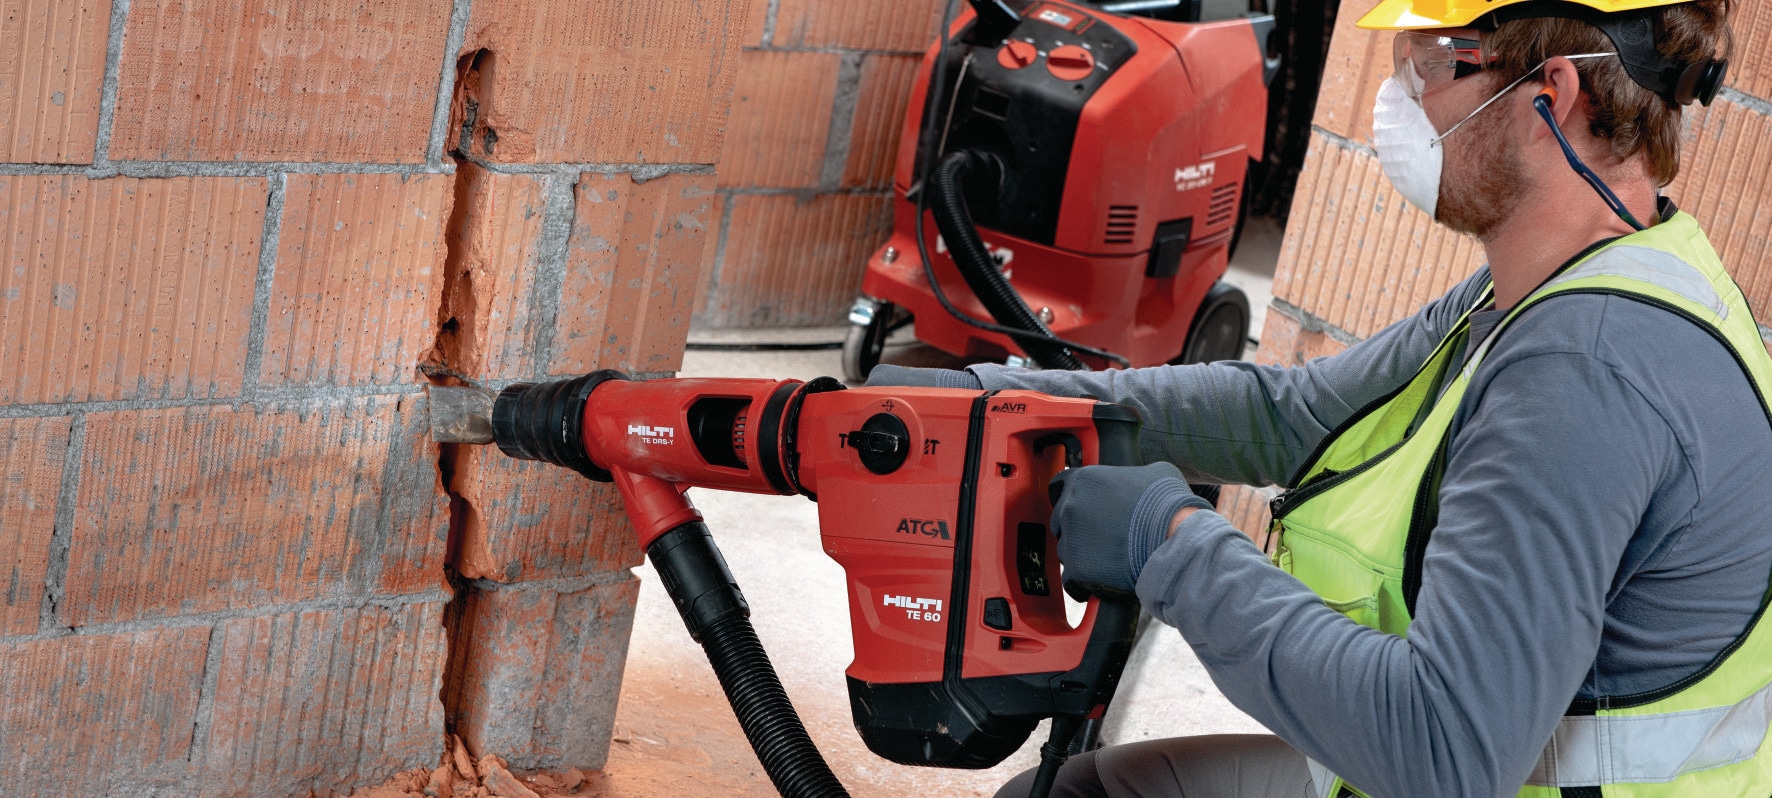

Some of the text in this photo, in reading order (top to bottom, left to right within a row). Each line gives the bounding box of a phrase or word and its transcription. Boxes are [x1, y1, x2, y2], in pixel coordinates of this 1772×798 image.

[1174, 160, 1216, 183] HILTI
[1001, 402, 1026, 414] AVR
[627, 424, 674, 438] HILTI
[652, 437, 674, 445] DRS-Y
[883, 594, 943, 612] HILTI
[906, 609, 941, 622] TE 60
